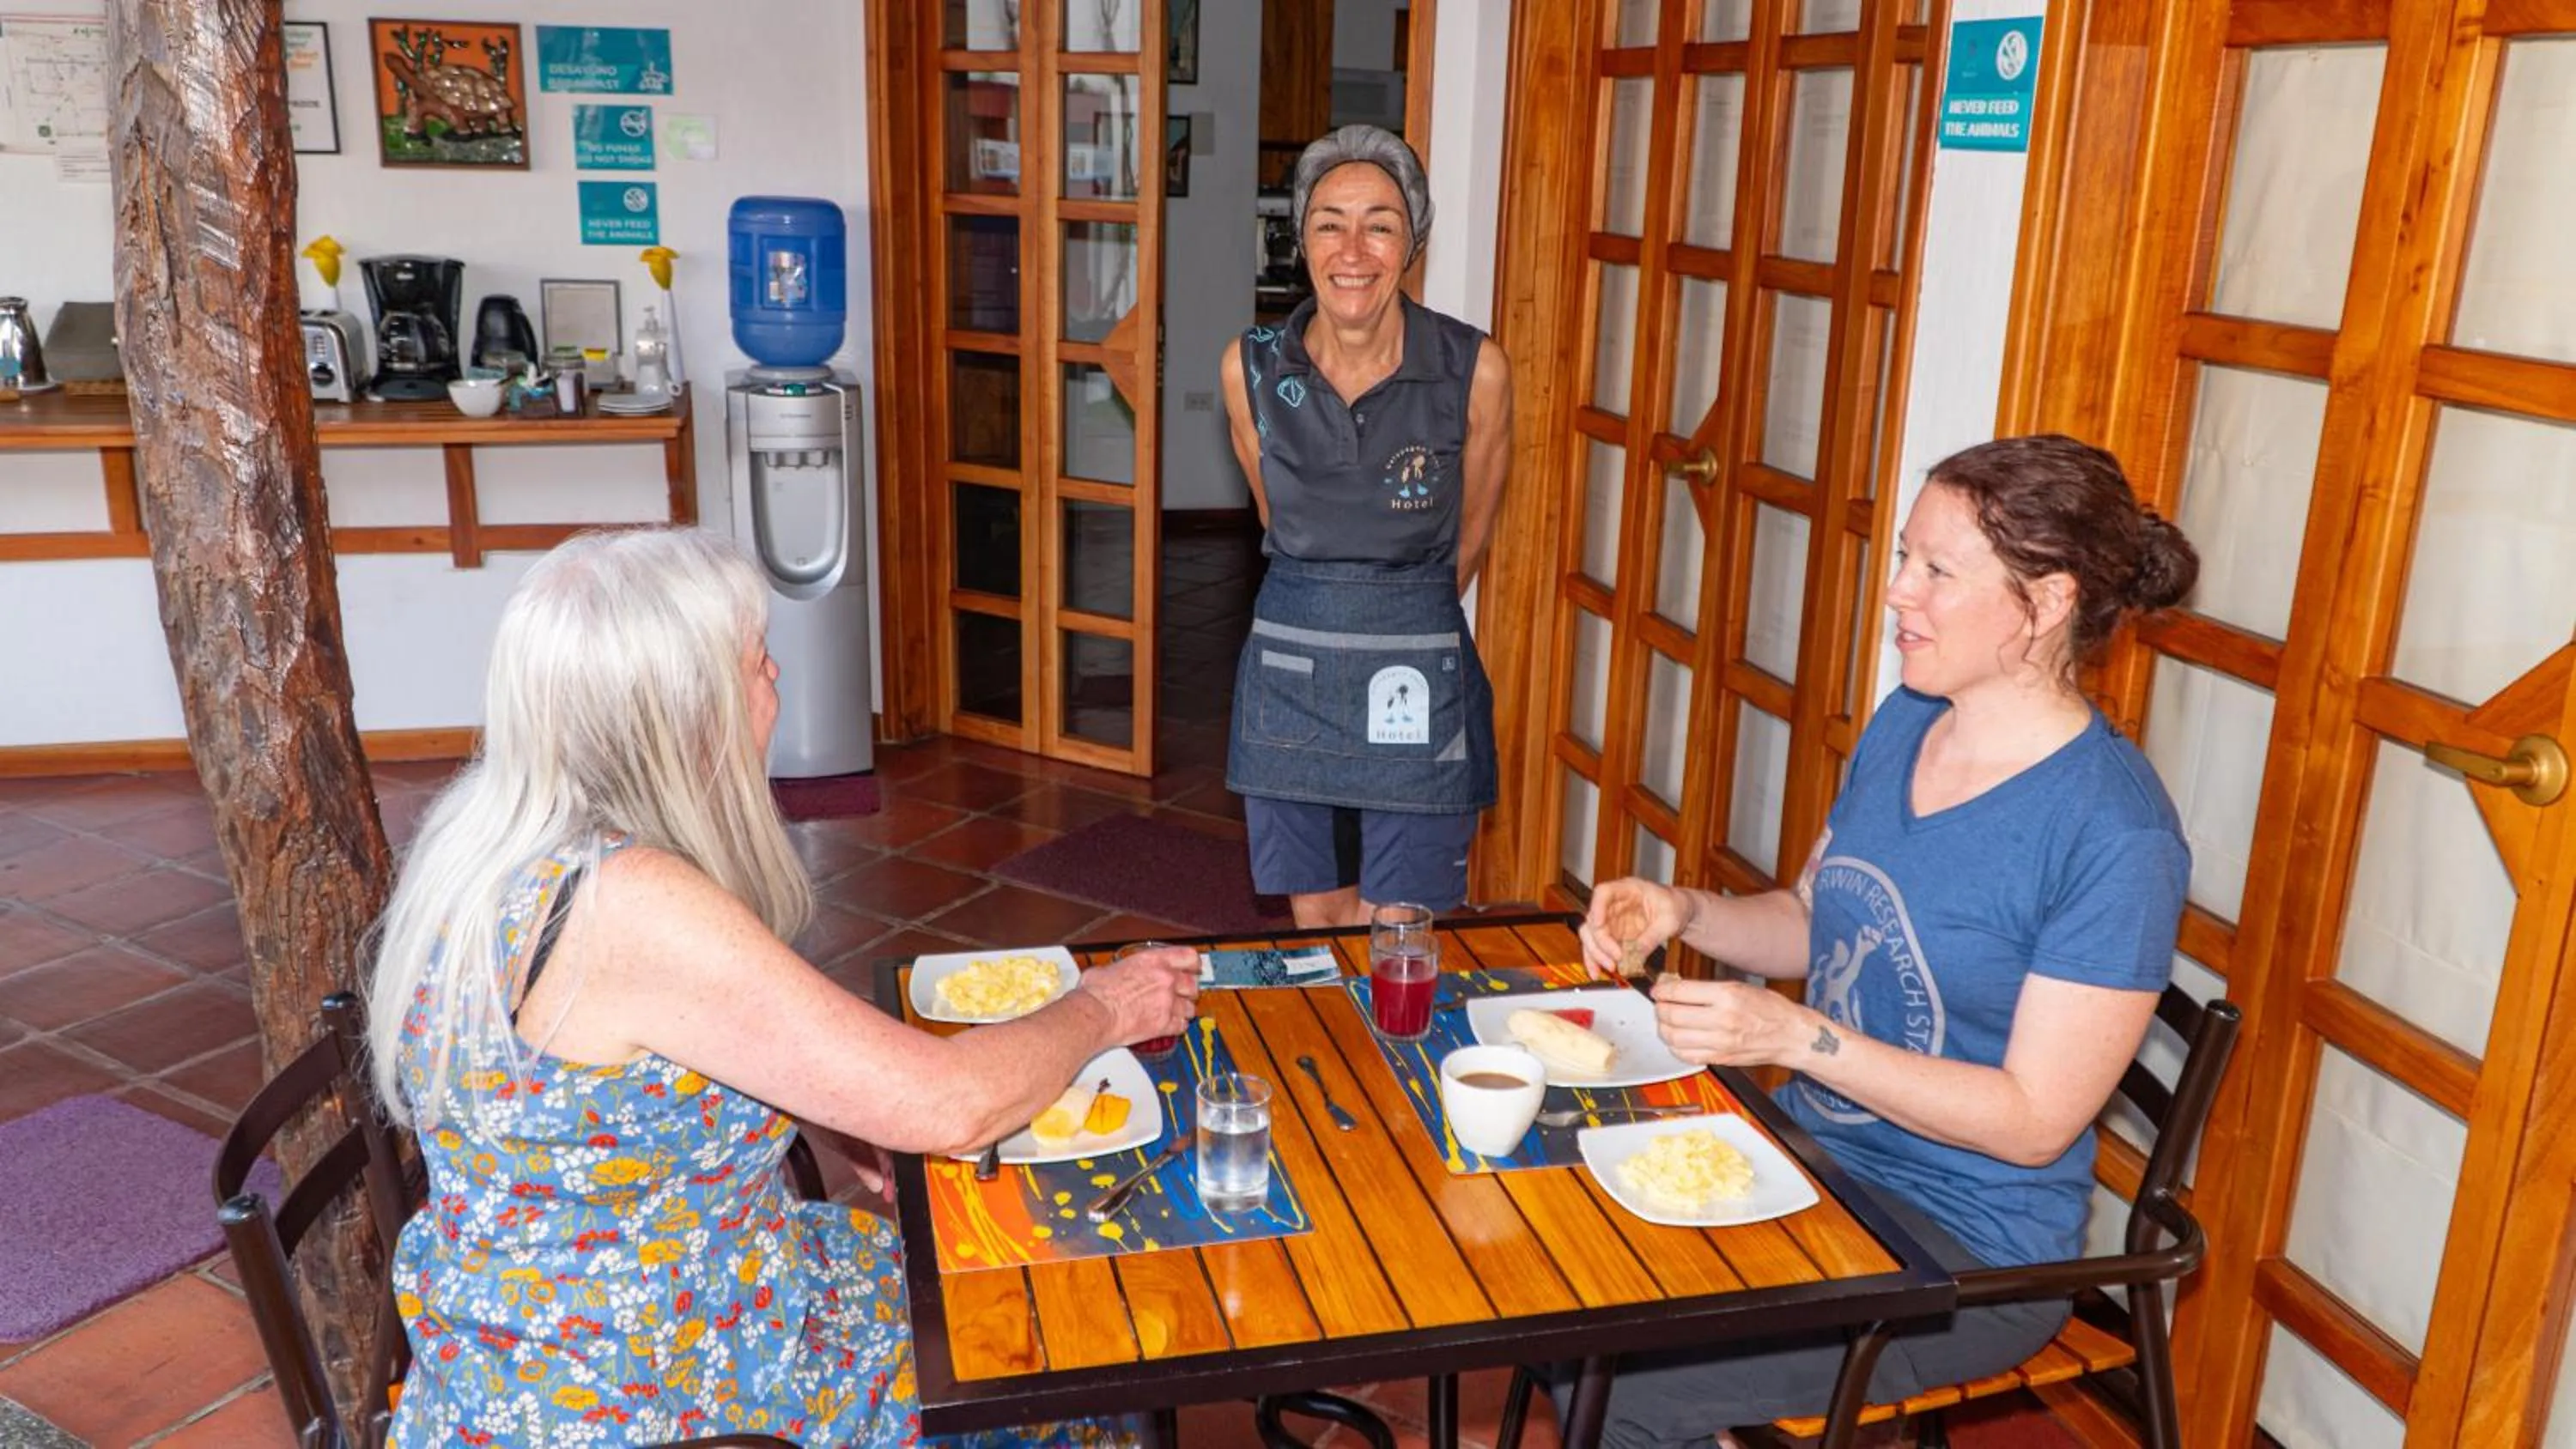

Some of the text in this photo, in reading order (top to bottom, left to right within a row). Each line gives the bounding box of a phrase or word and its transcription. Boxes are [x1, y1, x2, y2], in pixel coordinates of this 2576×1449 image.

[1948, 99, 2020, 115] NEVER FEED
[1945, 121, 2020, 138] THE ANIMALS
[587, 219, 652, 229] NEVER FEED
[609, 231, 654, 239] ANIMALS
[1391, 497, 1434, 510] Hotel
[1376, 729, 1422, 740] Hotel
[1816, 867, 1931, 1053] RWIN RESEARCH STA
